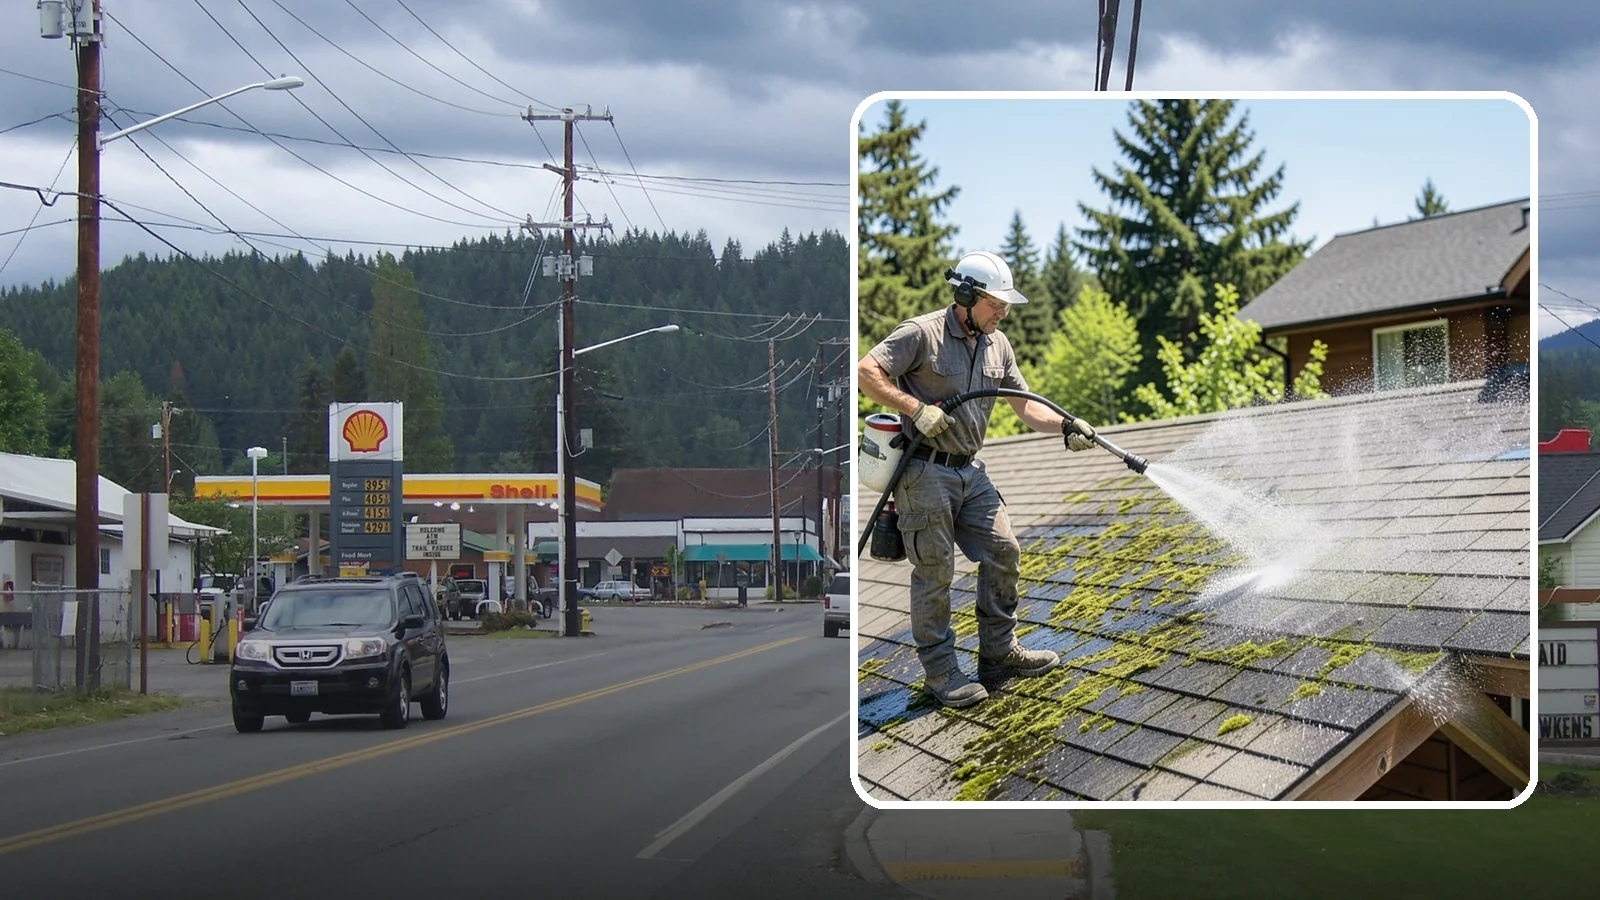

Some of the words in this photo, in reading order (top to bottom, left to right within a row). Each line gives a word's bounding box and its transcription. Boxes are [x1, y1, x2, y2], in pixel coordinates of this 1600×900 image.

[366, 480, 383, 490] 395
[490, 484, 547, 498] Shell
[366, 494, 383, 504] 405
[366, 508, 383, 518] 415
[366, 522, 383, 532] 429
